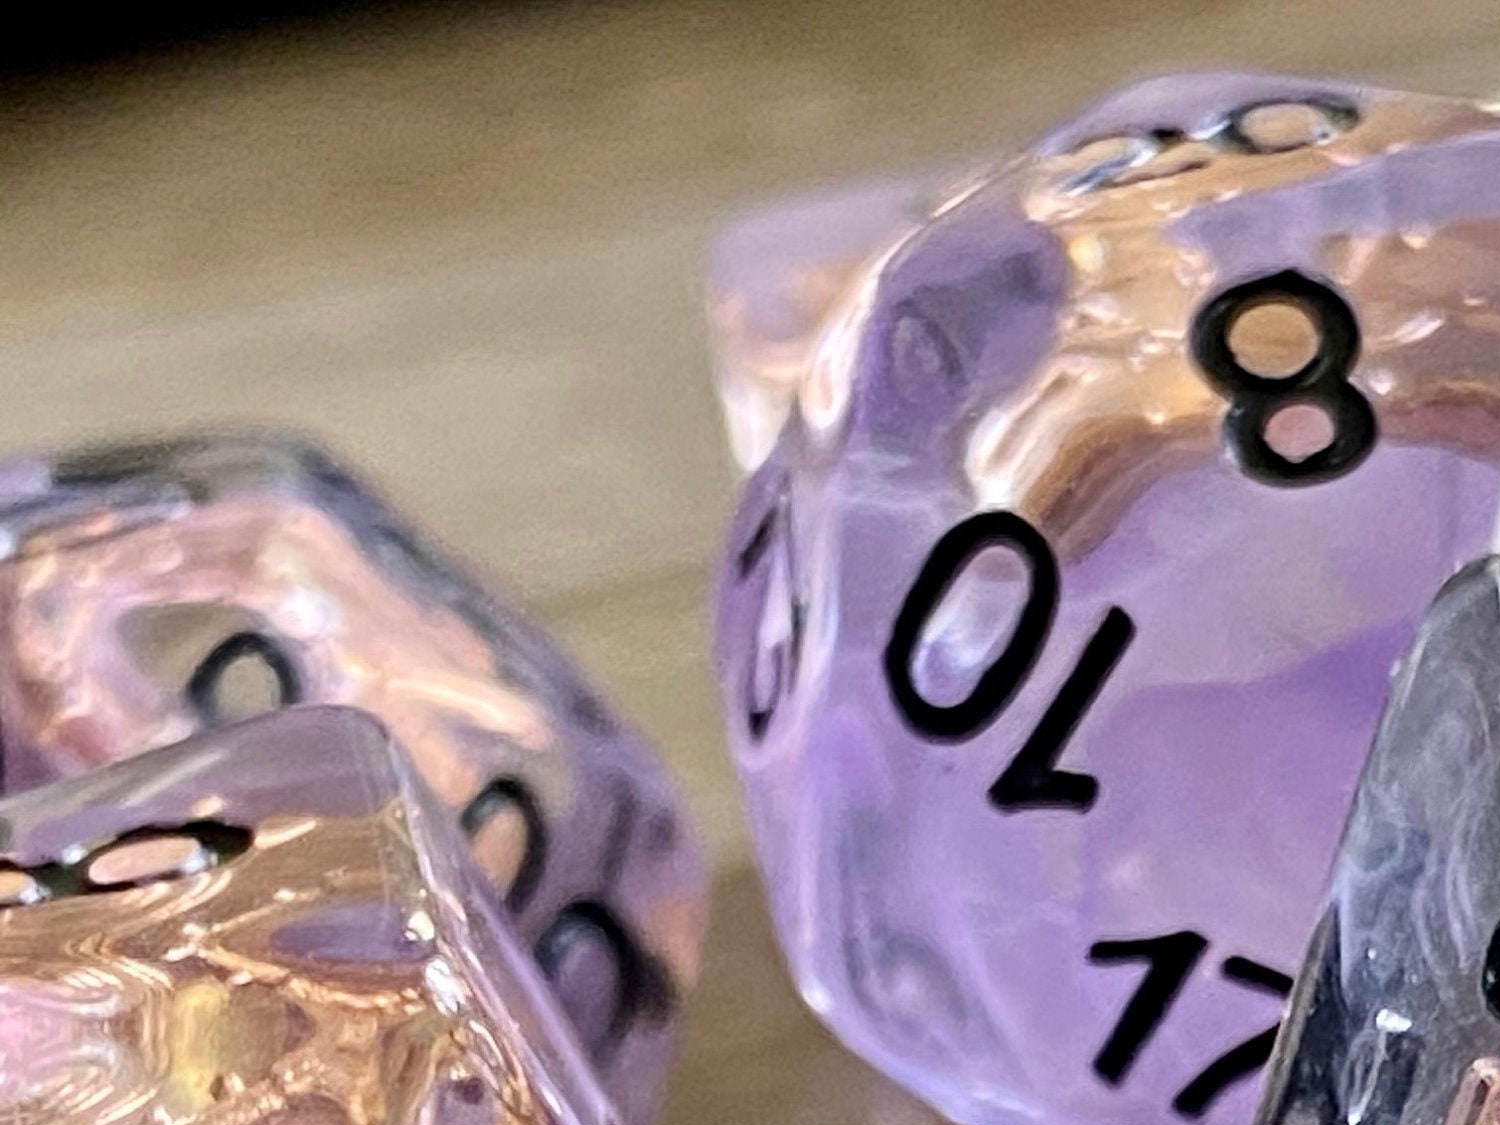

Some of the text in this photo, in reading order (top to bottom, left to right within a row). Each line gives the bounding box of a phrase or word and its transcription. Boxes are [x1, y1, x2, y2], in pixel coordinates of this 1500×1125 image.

[1187, 268, 1378, 490] 8
[884, 510, 1136, 814] 10
[1086, 928, 1296, 1122] 17
